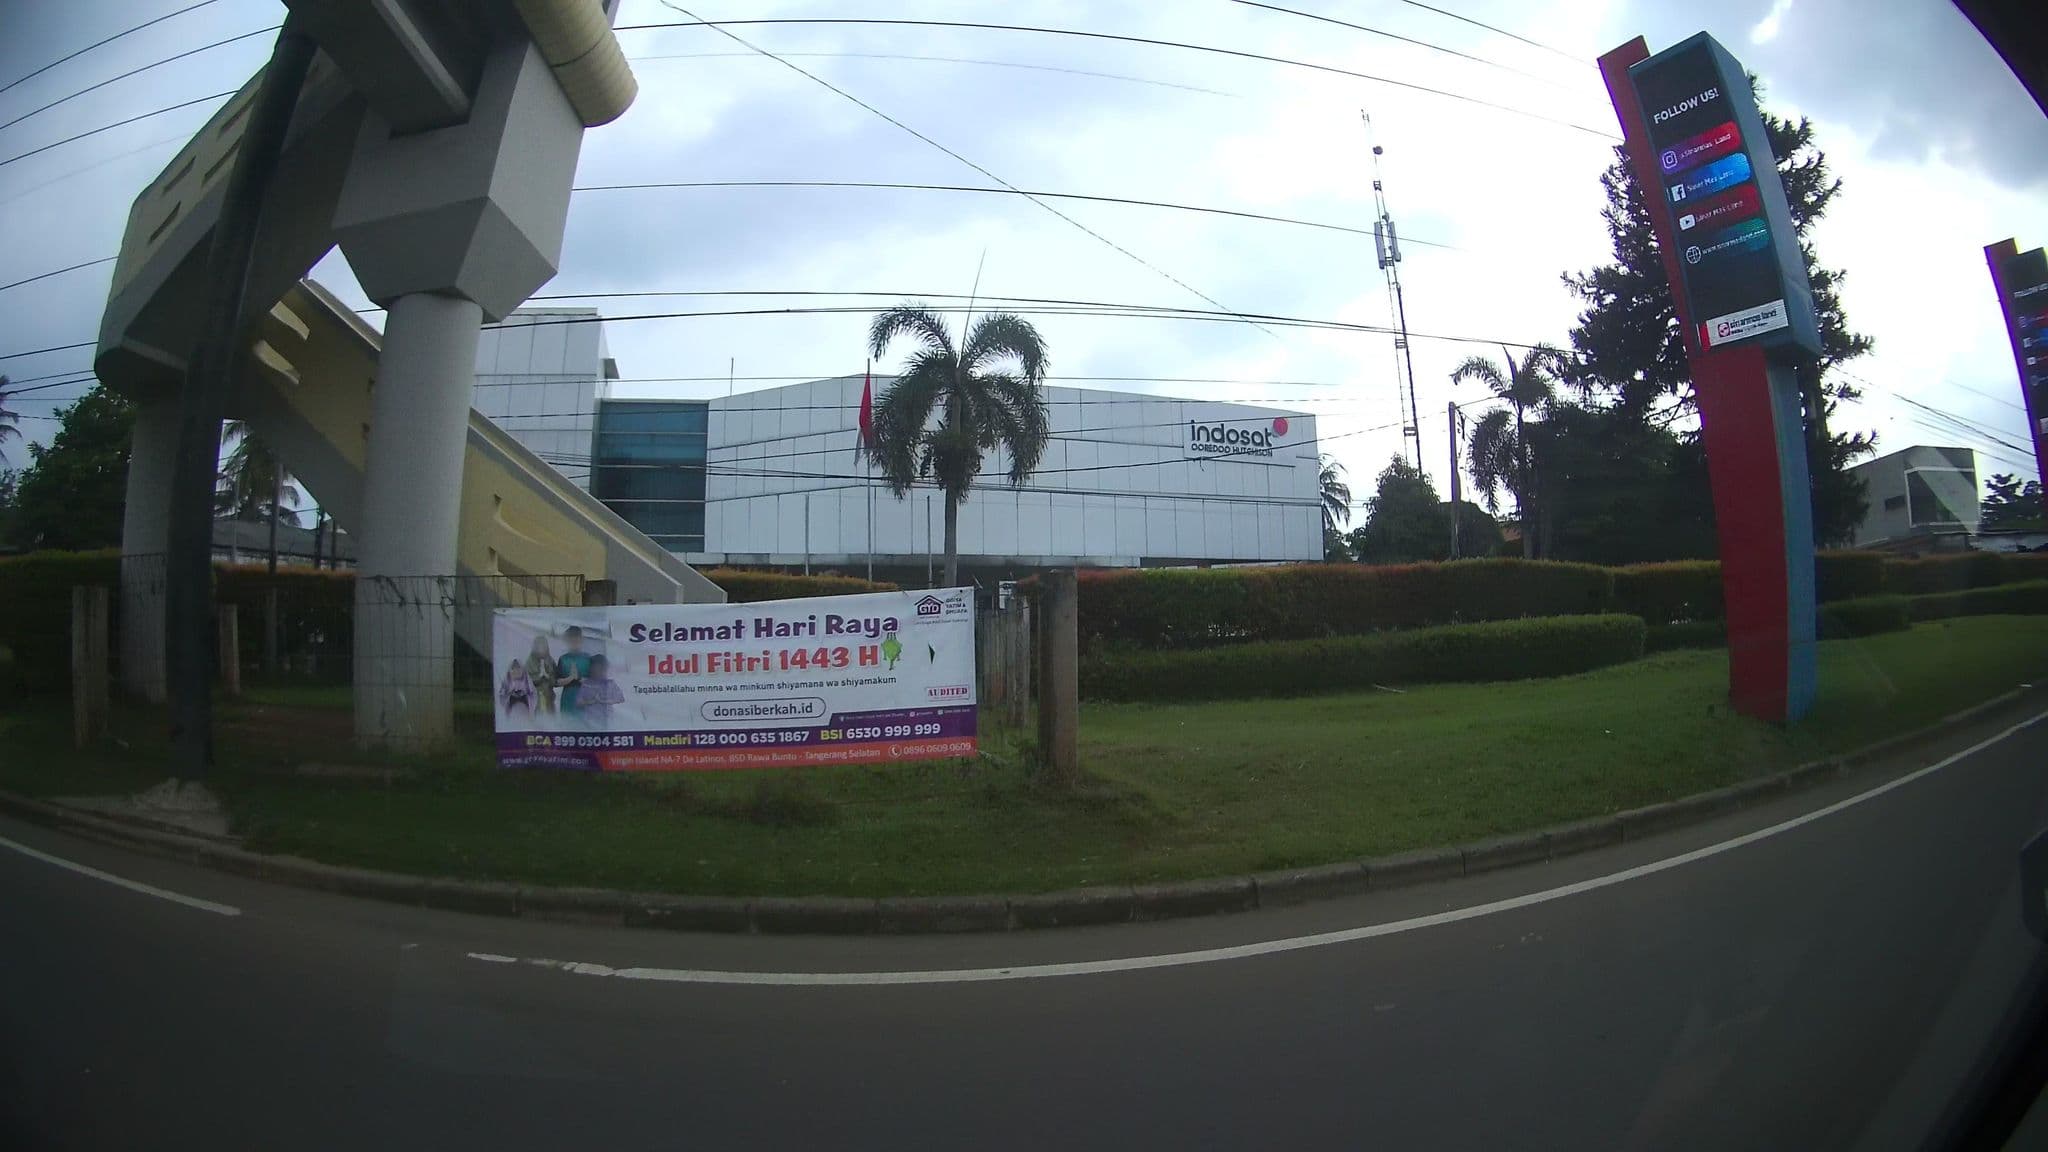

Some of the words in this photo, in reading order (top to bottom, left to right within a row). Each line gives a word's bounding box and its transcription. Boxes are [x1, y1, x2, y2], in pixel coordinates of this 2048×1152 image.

[1653, 96, 1699, 124] FOLLOW
[1700, 87, 1720, 103] US!
[1190, 419, 1273, 448] indosat
[1191, 443, 1231, 453] OOREDOO
[919, 603, 940, 614] GYD
[629, 619, 746, 643] Selamat
[754, 614, 817, 638] Hari
[825, 614, 899, 639] Raya
[648, 653, 699, 675] Idul
[707, 649, 770, 673] Fitri
[779, 646, 850, 671] 1443
[858, 644, 879, 667] H
[633, 684, 696, 696] Taqabbalallahu
[697, 684, 724, 693] minna
[725, 684, 738, 692] wa
[740, 681, 776, 692] minkum
[777, 678, 824, 692] shiyamana
[826, 679, 839, 688] wa
[841, 675, 897, 688] shiyamakum
[928, 687, 968, 698] AUDITED
[713, 702, 813, 717] donasiberkah.id
[526, 735, 552, 746] BCA
[554, 735, 576, 747] 899
[578, 735, 611, 747] 0304
[613, 735, 634, 747] 581
[644, 734, 691, 746] Mandiri
[694, 733, 716, 745] 128
[719, 732, 748, 744] 000
[750, 732, 776, 744] 635
[778, 730, 810, 743] 1867
[820, 728, 842, 741] BSI
[846, 726, 881, 740] 6530
[884, 724, 911, 737] 999
[914, 722, 941, 735] 999
[805, 750, 848, 762] Tangerang
[848, 748, 881, 759] Selatan
